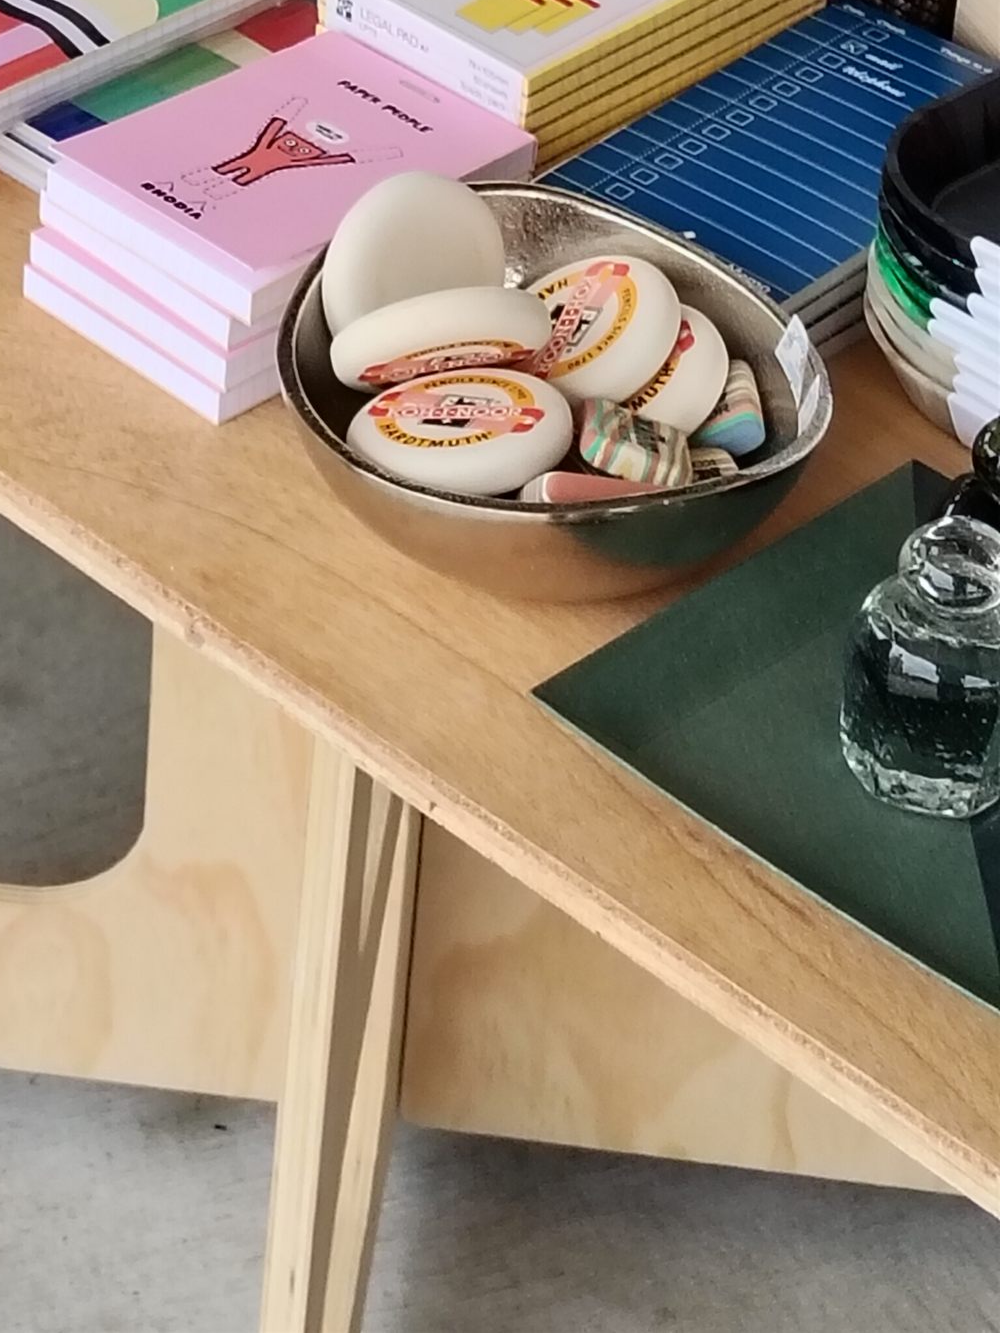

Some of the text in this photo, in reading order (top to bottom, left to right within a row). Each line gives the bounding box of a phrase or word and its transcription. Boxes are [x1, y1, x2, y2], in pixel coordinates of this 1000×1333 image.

[337, 80, 382, 104] PAPER
[382, 104, 433, 133] PEOPLE
[141, 182, 202, 220] RHODIA
[379, 422, 493, 448] HARDTMUTH
